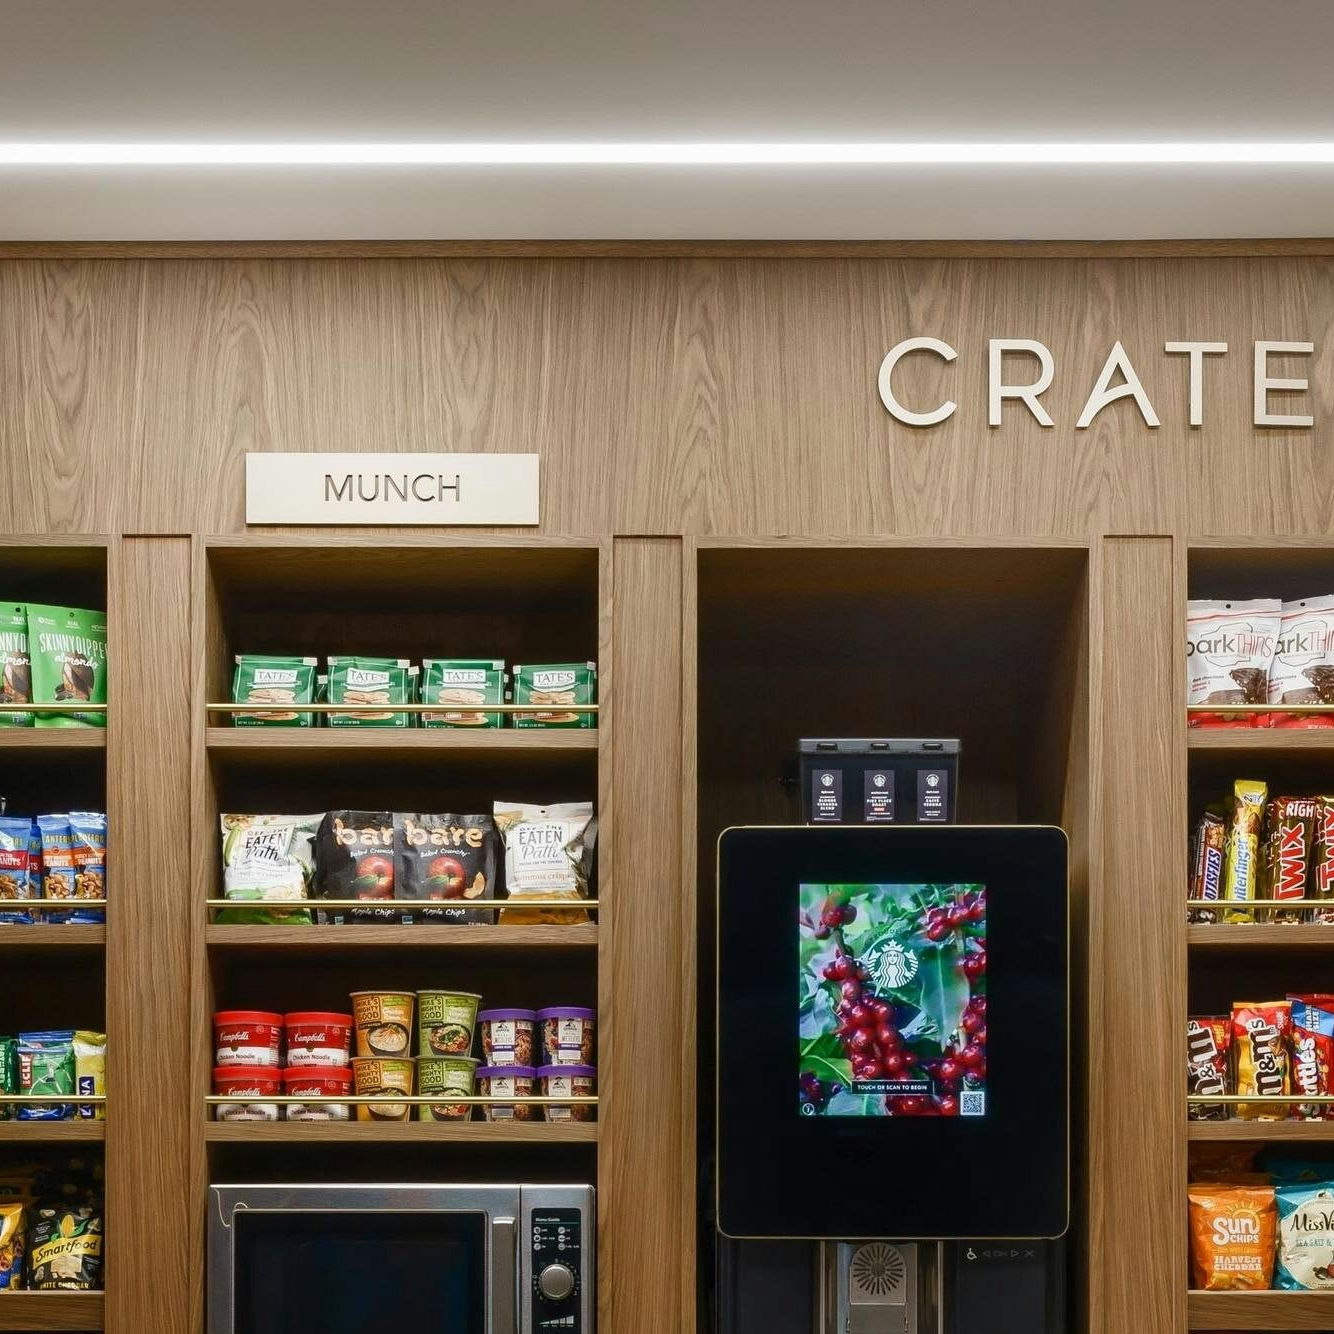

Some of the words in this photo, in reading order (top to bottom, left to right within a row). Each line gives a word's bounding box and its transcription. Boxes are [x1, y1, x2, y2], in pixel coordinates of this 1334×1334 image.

[878, 336, 1314, 429] CRATE
[324, 474, 460, 501] MUNCH
[54, 653, 98, 669] almonds
[445, 671, 484, 680] TATE'S
[536, 672, 574, 684] TATE'S
[246, 833, 287, 850] EATEN
[404, 820, 484, 848] bare
[519, 830, 563, 846] EATEN
[1234, 837, 1249, 912] utterfinger
[375, 908, 395, 917] Chips
[445, 908, 466, 917] Chips
[1305, 1004, 1313, 1032] SHARE
[1312, 1010, 1321, 1031] SIZE
[1230, 1234, 1259, 1243] CHIPS
[1309, 1238, 1325, 1247] SALT
[35, 1239, 98, 1262] Smartfood
[1214, 1256, 1262, 1264] HARVEST
[1214, 1263, 1262, 1271] CHEDDAR
